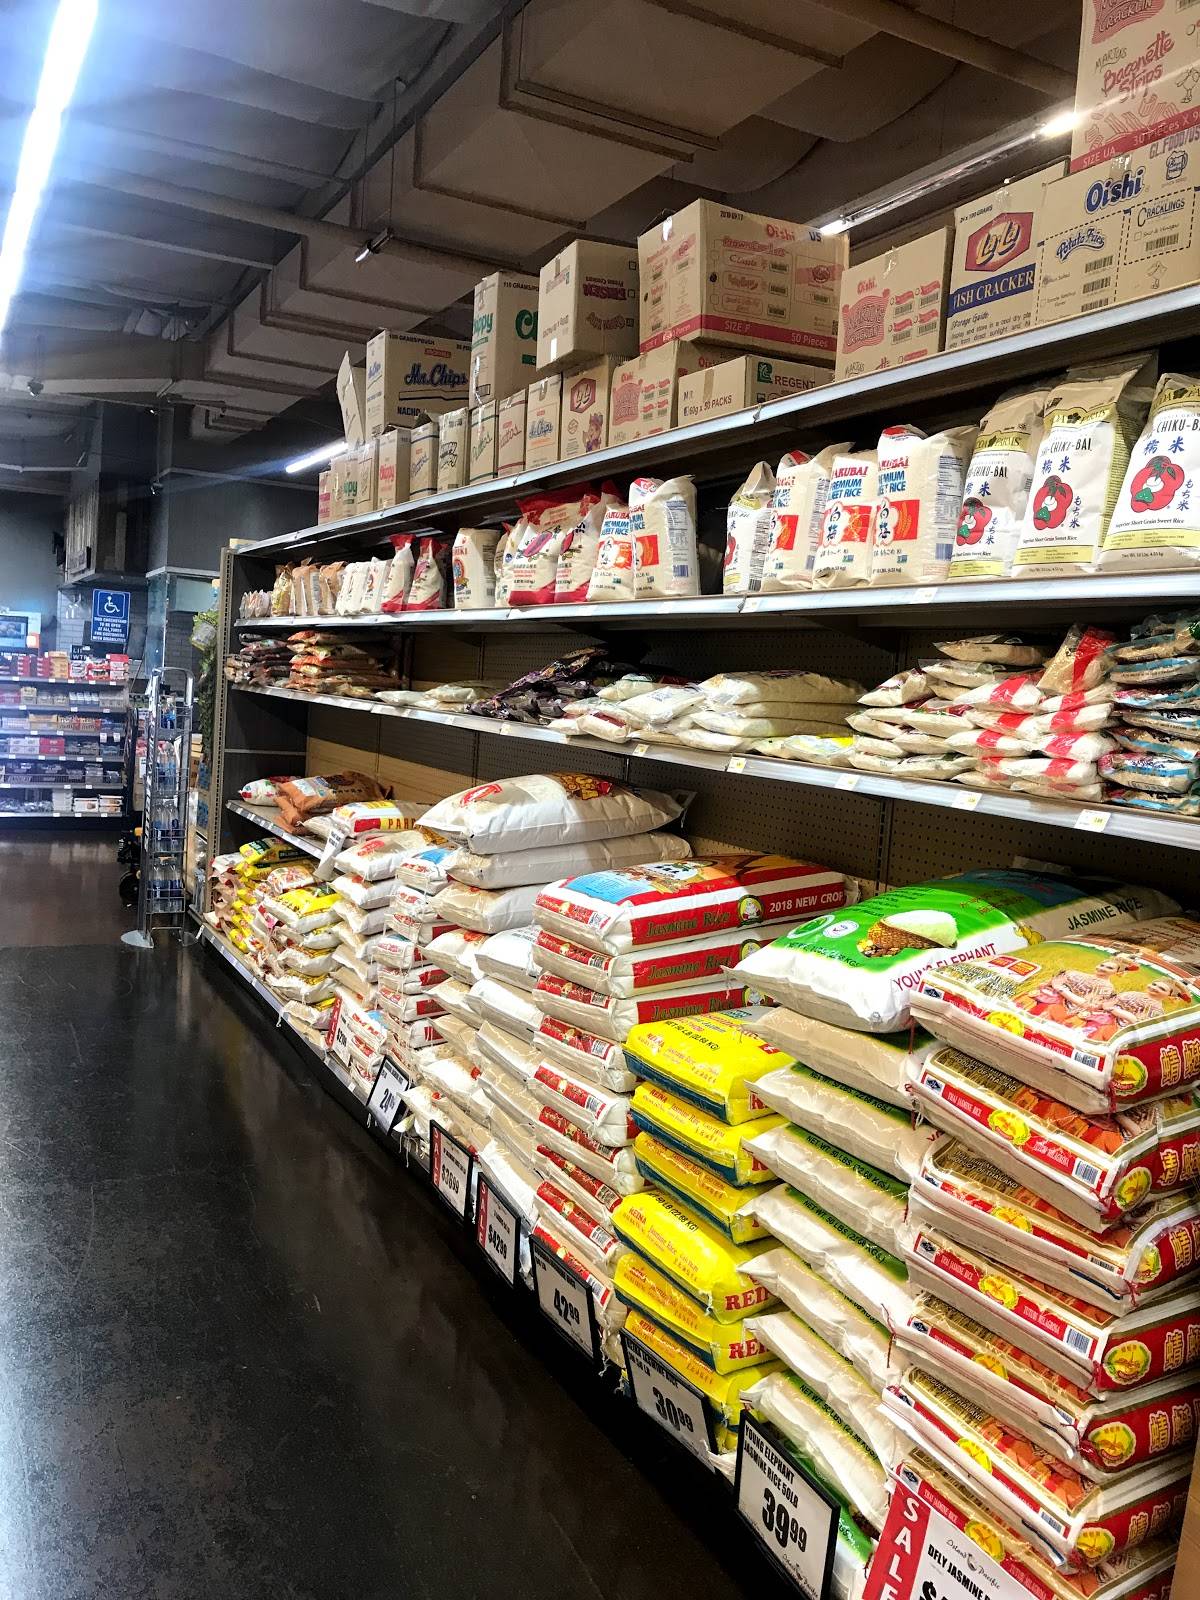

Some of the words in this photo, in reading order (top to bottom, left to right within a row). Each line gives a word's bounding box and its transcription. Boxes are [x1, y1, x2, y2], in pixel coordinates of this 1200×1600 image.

[1082, 151, 1102, 168] SIZE
[1086, 166, 1146, 214] Oishi
[1137, 197, 1187, 228] CRACKLINGS
[976, 270, 1035, 300] CRACKER
[724, 320, 743, 332] SIZE
[791, 332, 803, 343] 50
[803, 334, 829, 349] Pieces
[427, 363, 469, 388] Chips
[774, 374, 816, 390] REGENT
[711, 394, 732, 409] PACKS
[843, 487, 862, 498] RICE
[889, 480, 907, 493] RICE
[770, 900, 792, 913] 2018
[795, 896, 817, 909] NEW
[1067, 905, 1116, 931] JASMINE
[1116, 897, 1144, 915] RICE
[646, 917, 698, 937] Jasmine
[702, 910, 731, 927] Rice
[649, 961, 700, 979] Jasmine
[651, 1003, 704, 1022] Jasmine
[951, 1055, 977, 1071] PRODUCT
[807, 1135, 819, 1147] NET
[832, 1150, 840, 1158] 50
[442, 1164, 460, 1194] $3699
[478, 1181, 486, 1244] SALE
[669, 1207, 688, 1223] (22.68
[686, 1219, 699, 1233] KG)
[803, 1200, 817, 1210] NET
[826, 1216, 834, 1225] 50
[488, 1223, 508, 1260] $4299
[800, 1384, 813, 1396] NET
[954, 1395, 984, 1422] THAILAND
[743, 1439, 767, 1475] JASMINE
[767, 1466, 782, 1490] RICE
[745, 1424, 765, 1450] YOUNG
[764, 1444, 795, 1485] ELEPHANT
[880, 1497, 919, 1600] SALE
[927, 1543, 948, 1568] DFLY
[946, 1562, 985, 1600] JASMINE
[946, 1536, 968, 1559] Island
[978, 1564, 1001, 1591] Pacific
